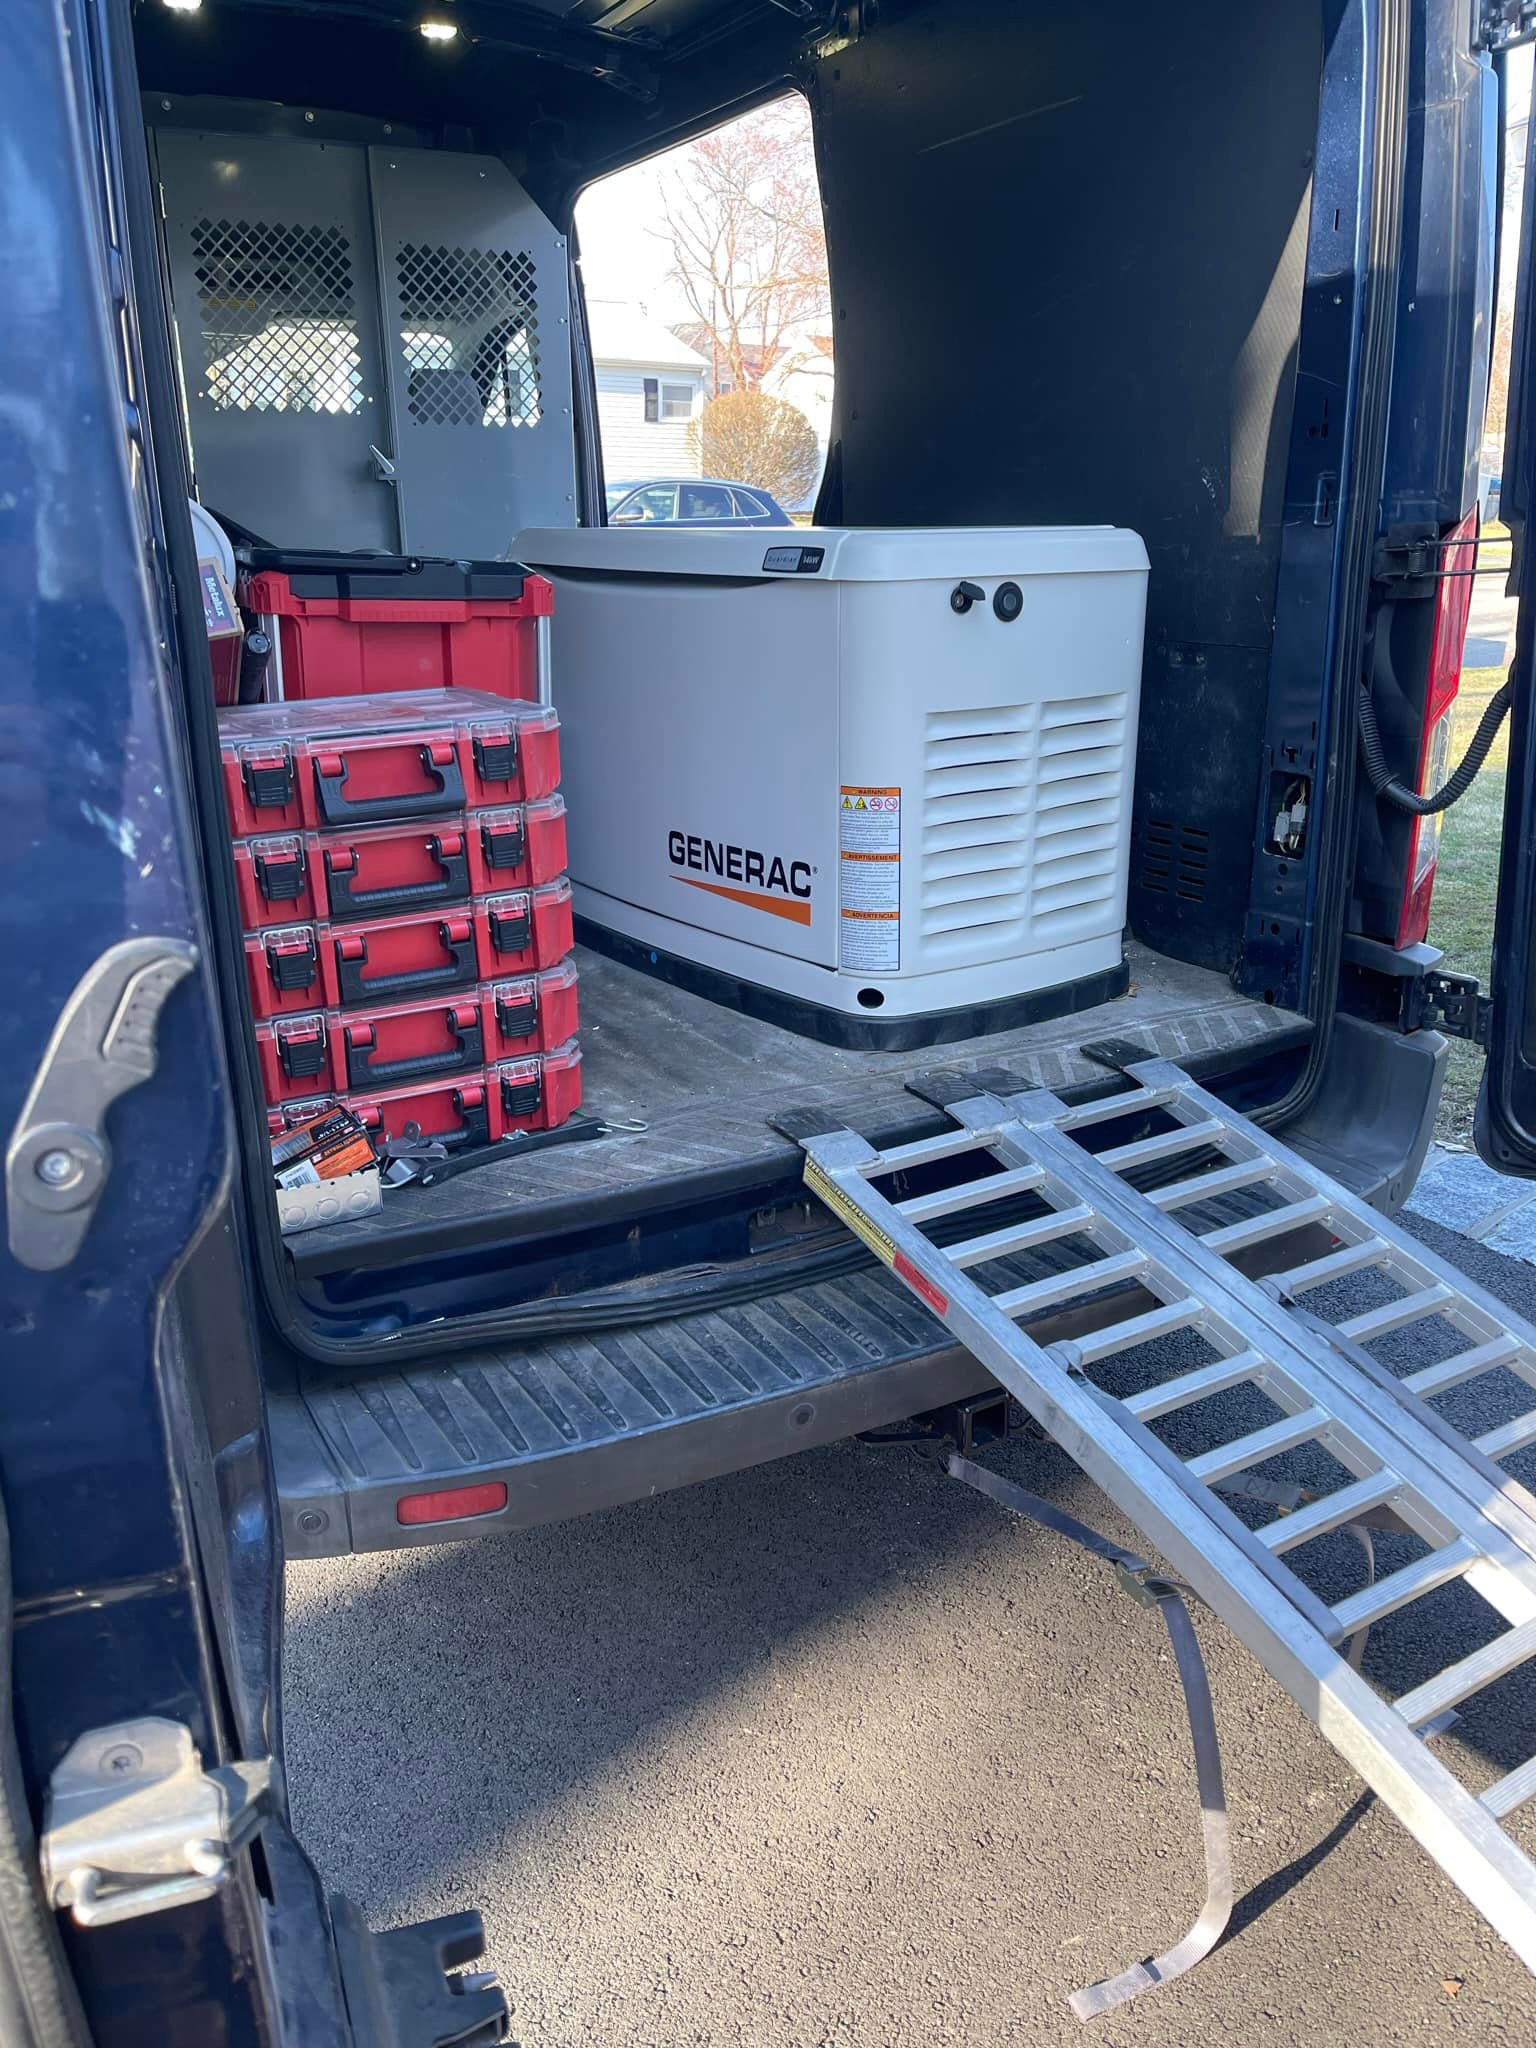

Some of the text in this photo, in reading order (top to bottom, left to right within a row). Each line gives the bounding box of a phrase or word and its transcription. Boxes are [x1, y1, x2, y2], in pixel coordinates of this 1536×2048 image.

[205, 577, 225, 617] Metalux
[668, 830, 811, 898] GENERAC
[848, 853, 897, 861] AVERTISSEMENT
